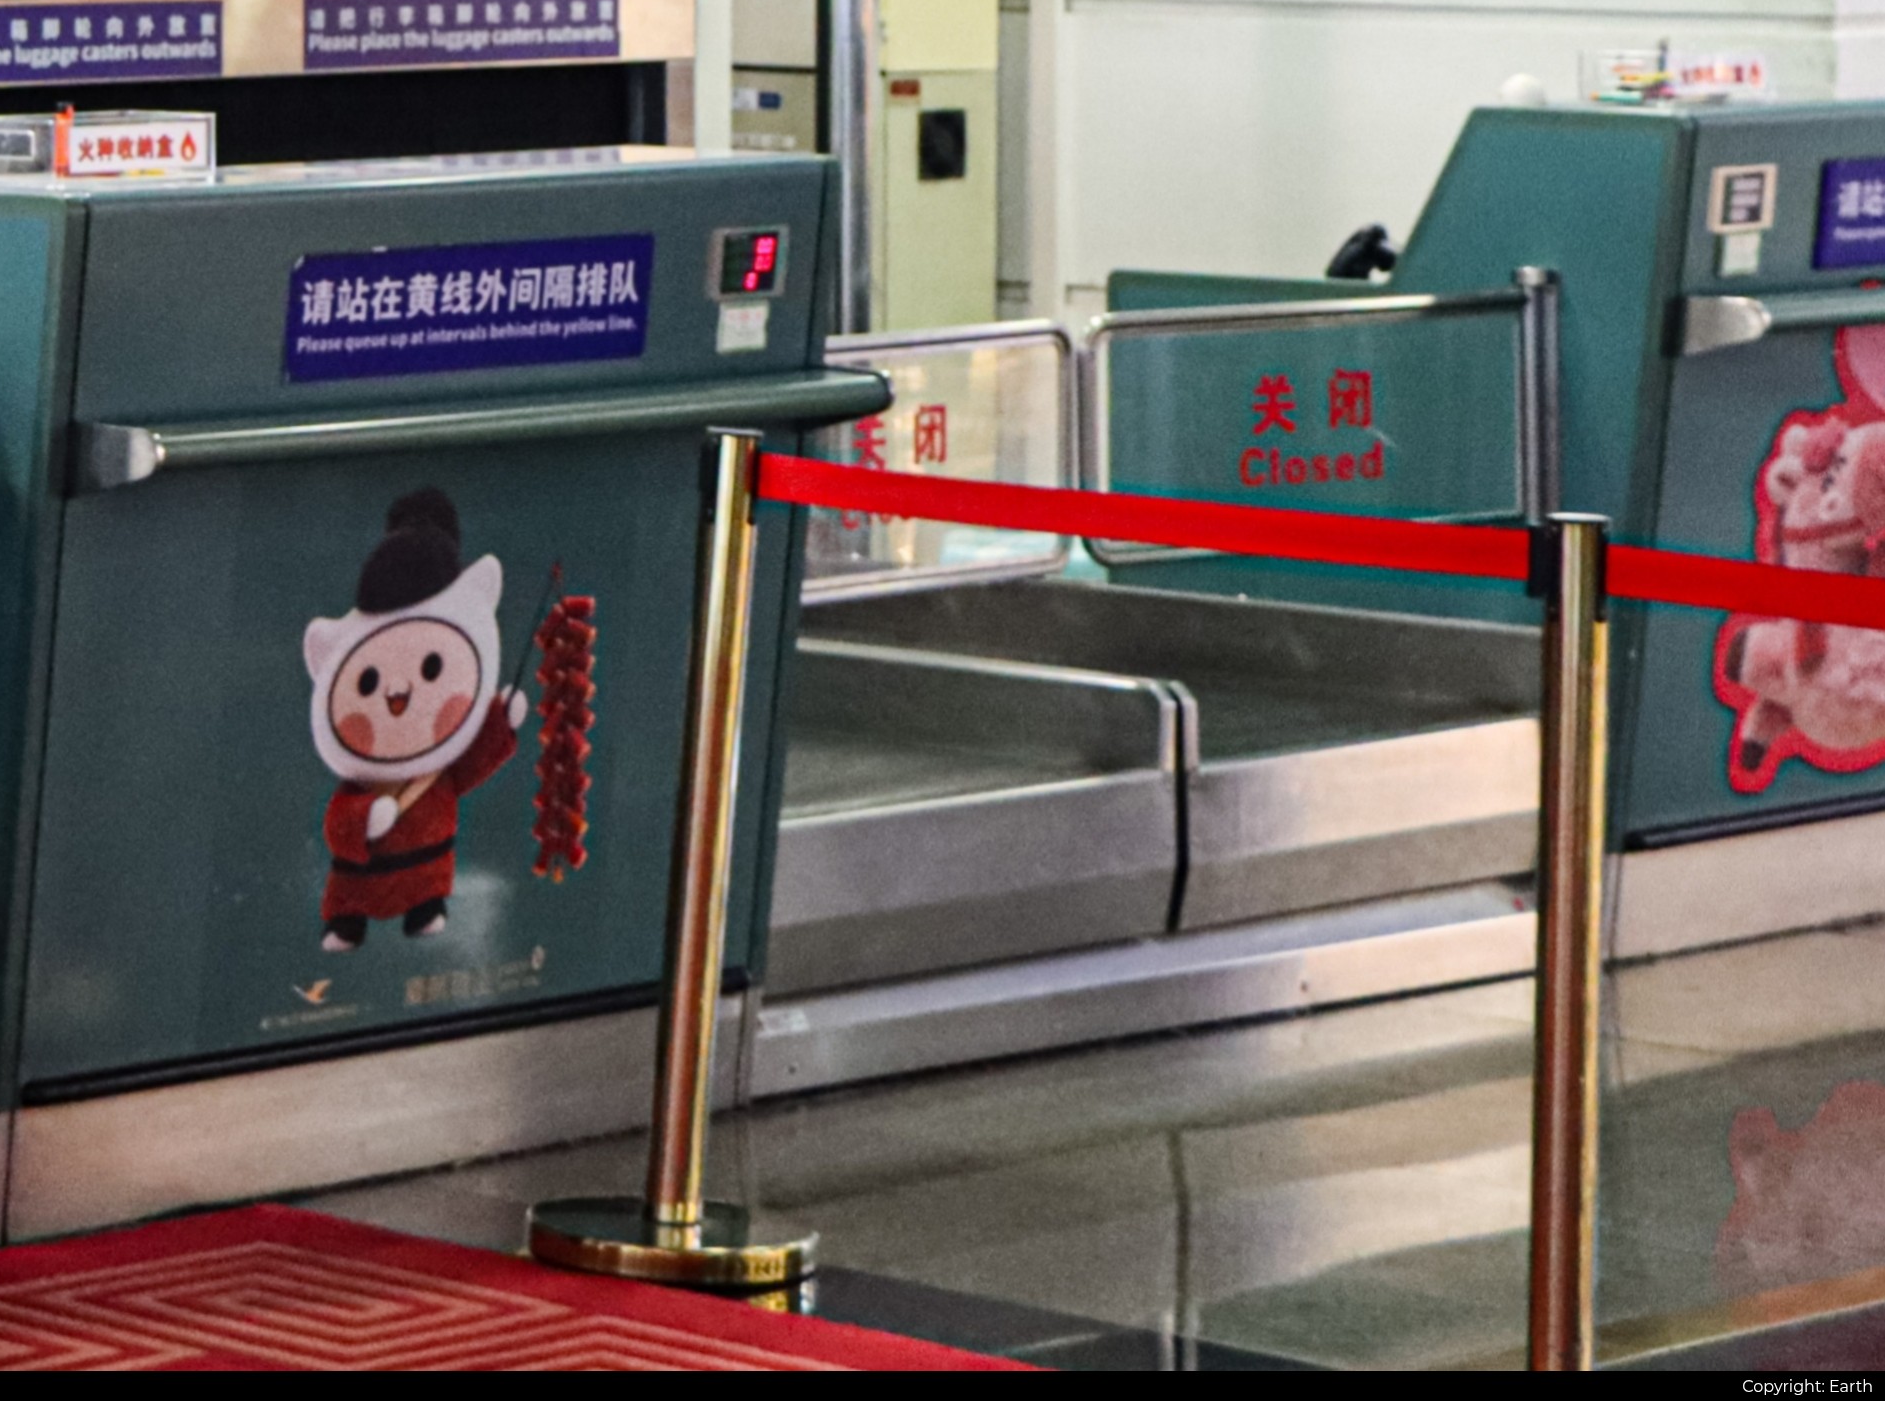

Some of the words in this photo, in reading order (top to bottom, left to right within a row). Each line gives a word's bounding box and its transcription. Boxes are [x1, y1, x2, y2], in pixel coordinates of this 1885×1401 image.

[15, 44, 78, 69] luggage
[81, 43, 138, 63] casters
[141, 38, 216, 59] outwards
[300, 260, 641, 326] 请站在黄线外间隔排队
[297, 335, 343, 354] Please
[344, 334, 387, 354] queue
[389, 332, 408, 349] up
[410, 330, 425, 345] at
[427, 325, 487, 344] intervals
[489, 321, 538, 339] behind
[540, 320, 561, 336] the
[562, 317, 606, 337] yellow
[1252, 368, 1373, 436] 关闭
[1238, 440, 1384, 488] Closed
